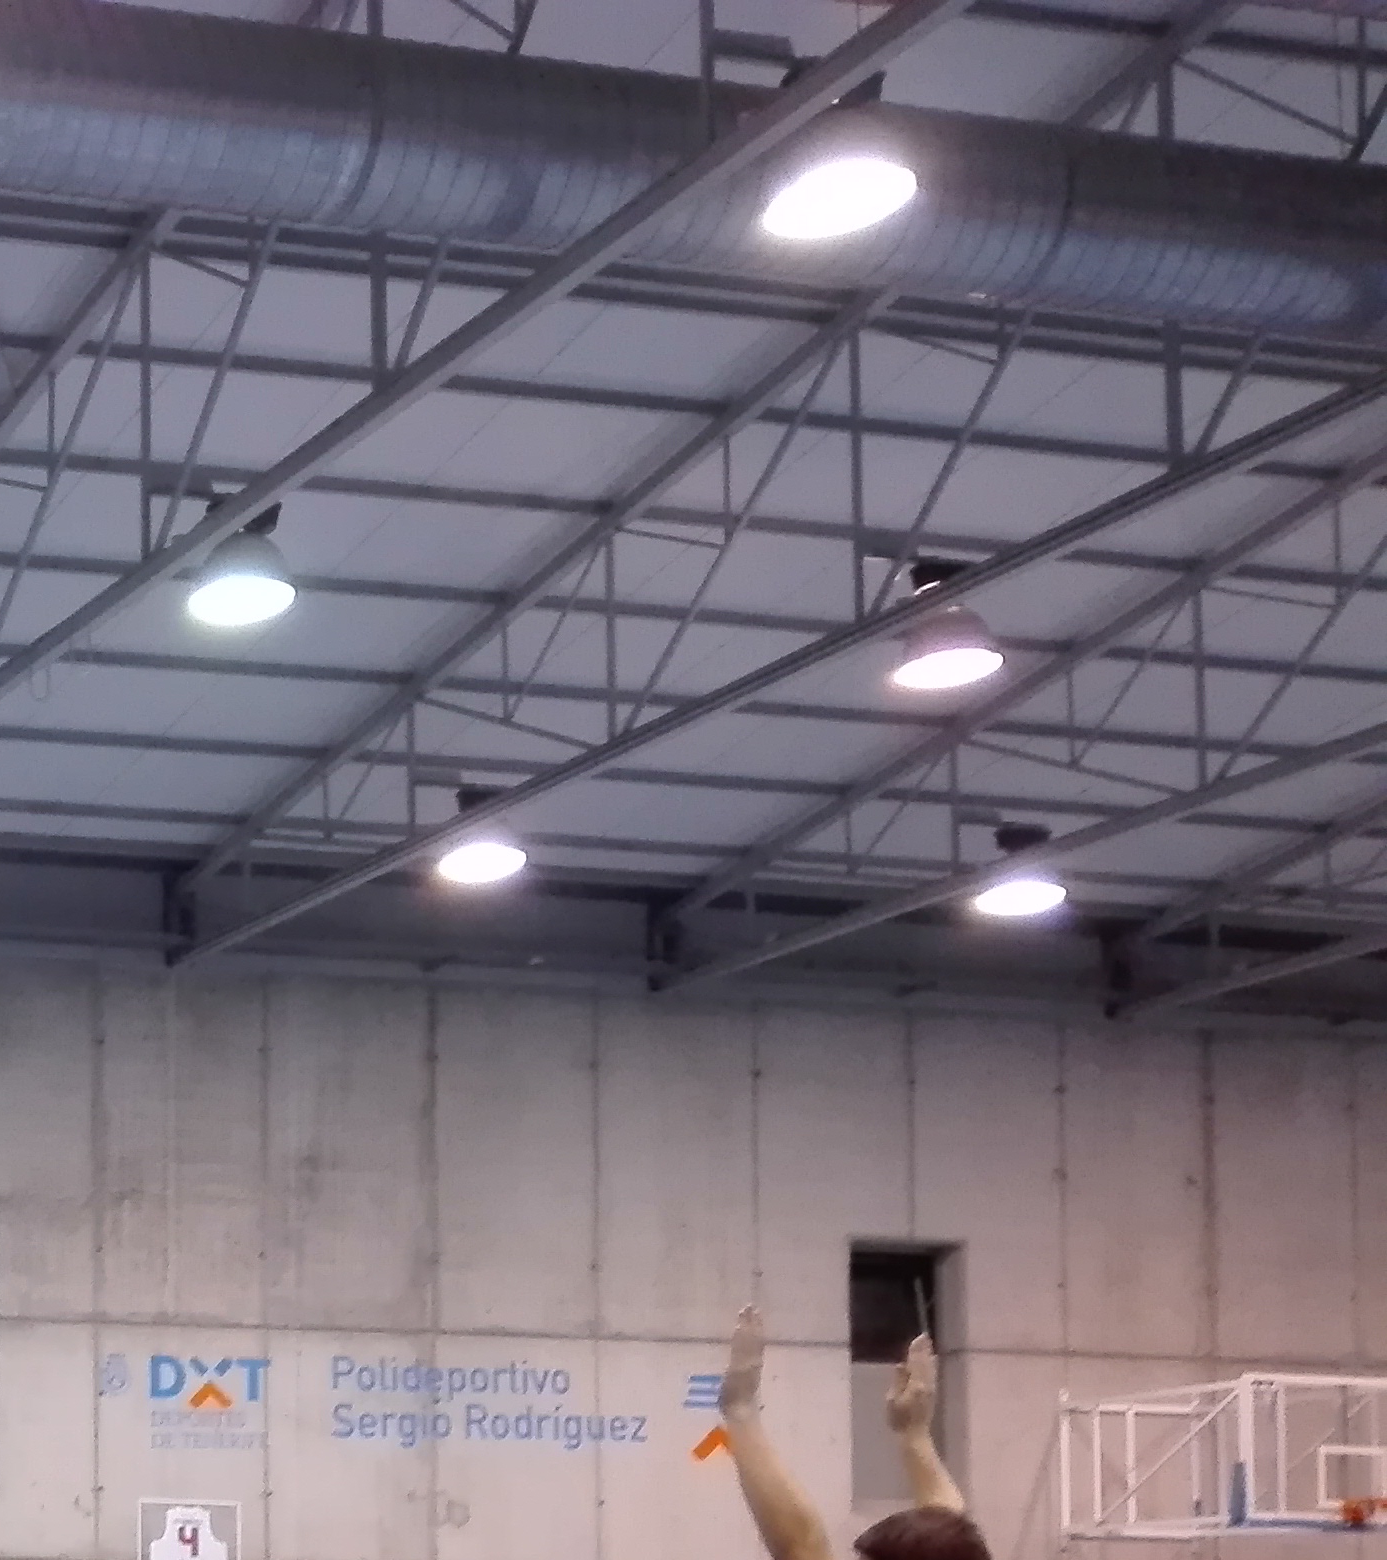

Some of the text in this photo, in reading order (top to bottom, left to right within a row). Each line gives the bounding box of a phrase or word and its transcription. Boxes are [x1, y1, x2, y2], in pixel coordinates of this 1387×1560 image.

[330, 1355, 571, 1402] Polideportivo
[330, 1403, 649, 1451] Sergio Rodríguez
[177, 1525, 200, 1557] 4
